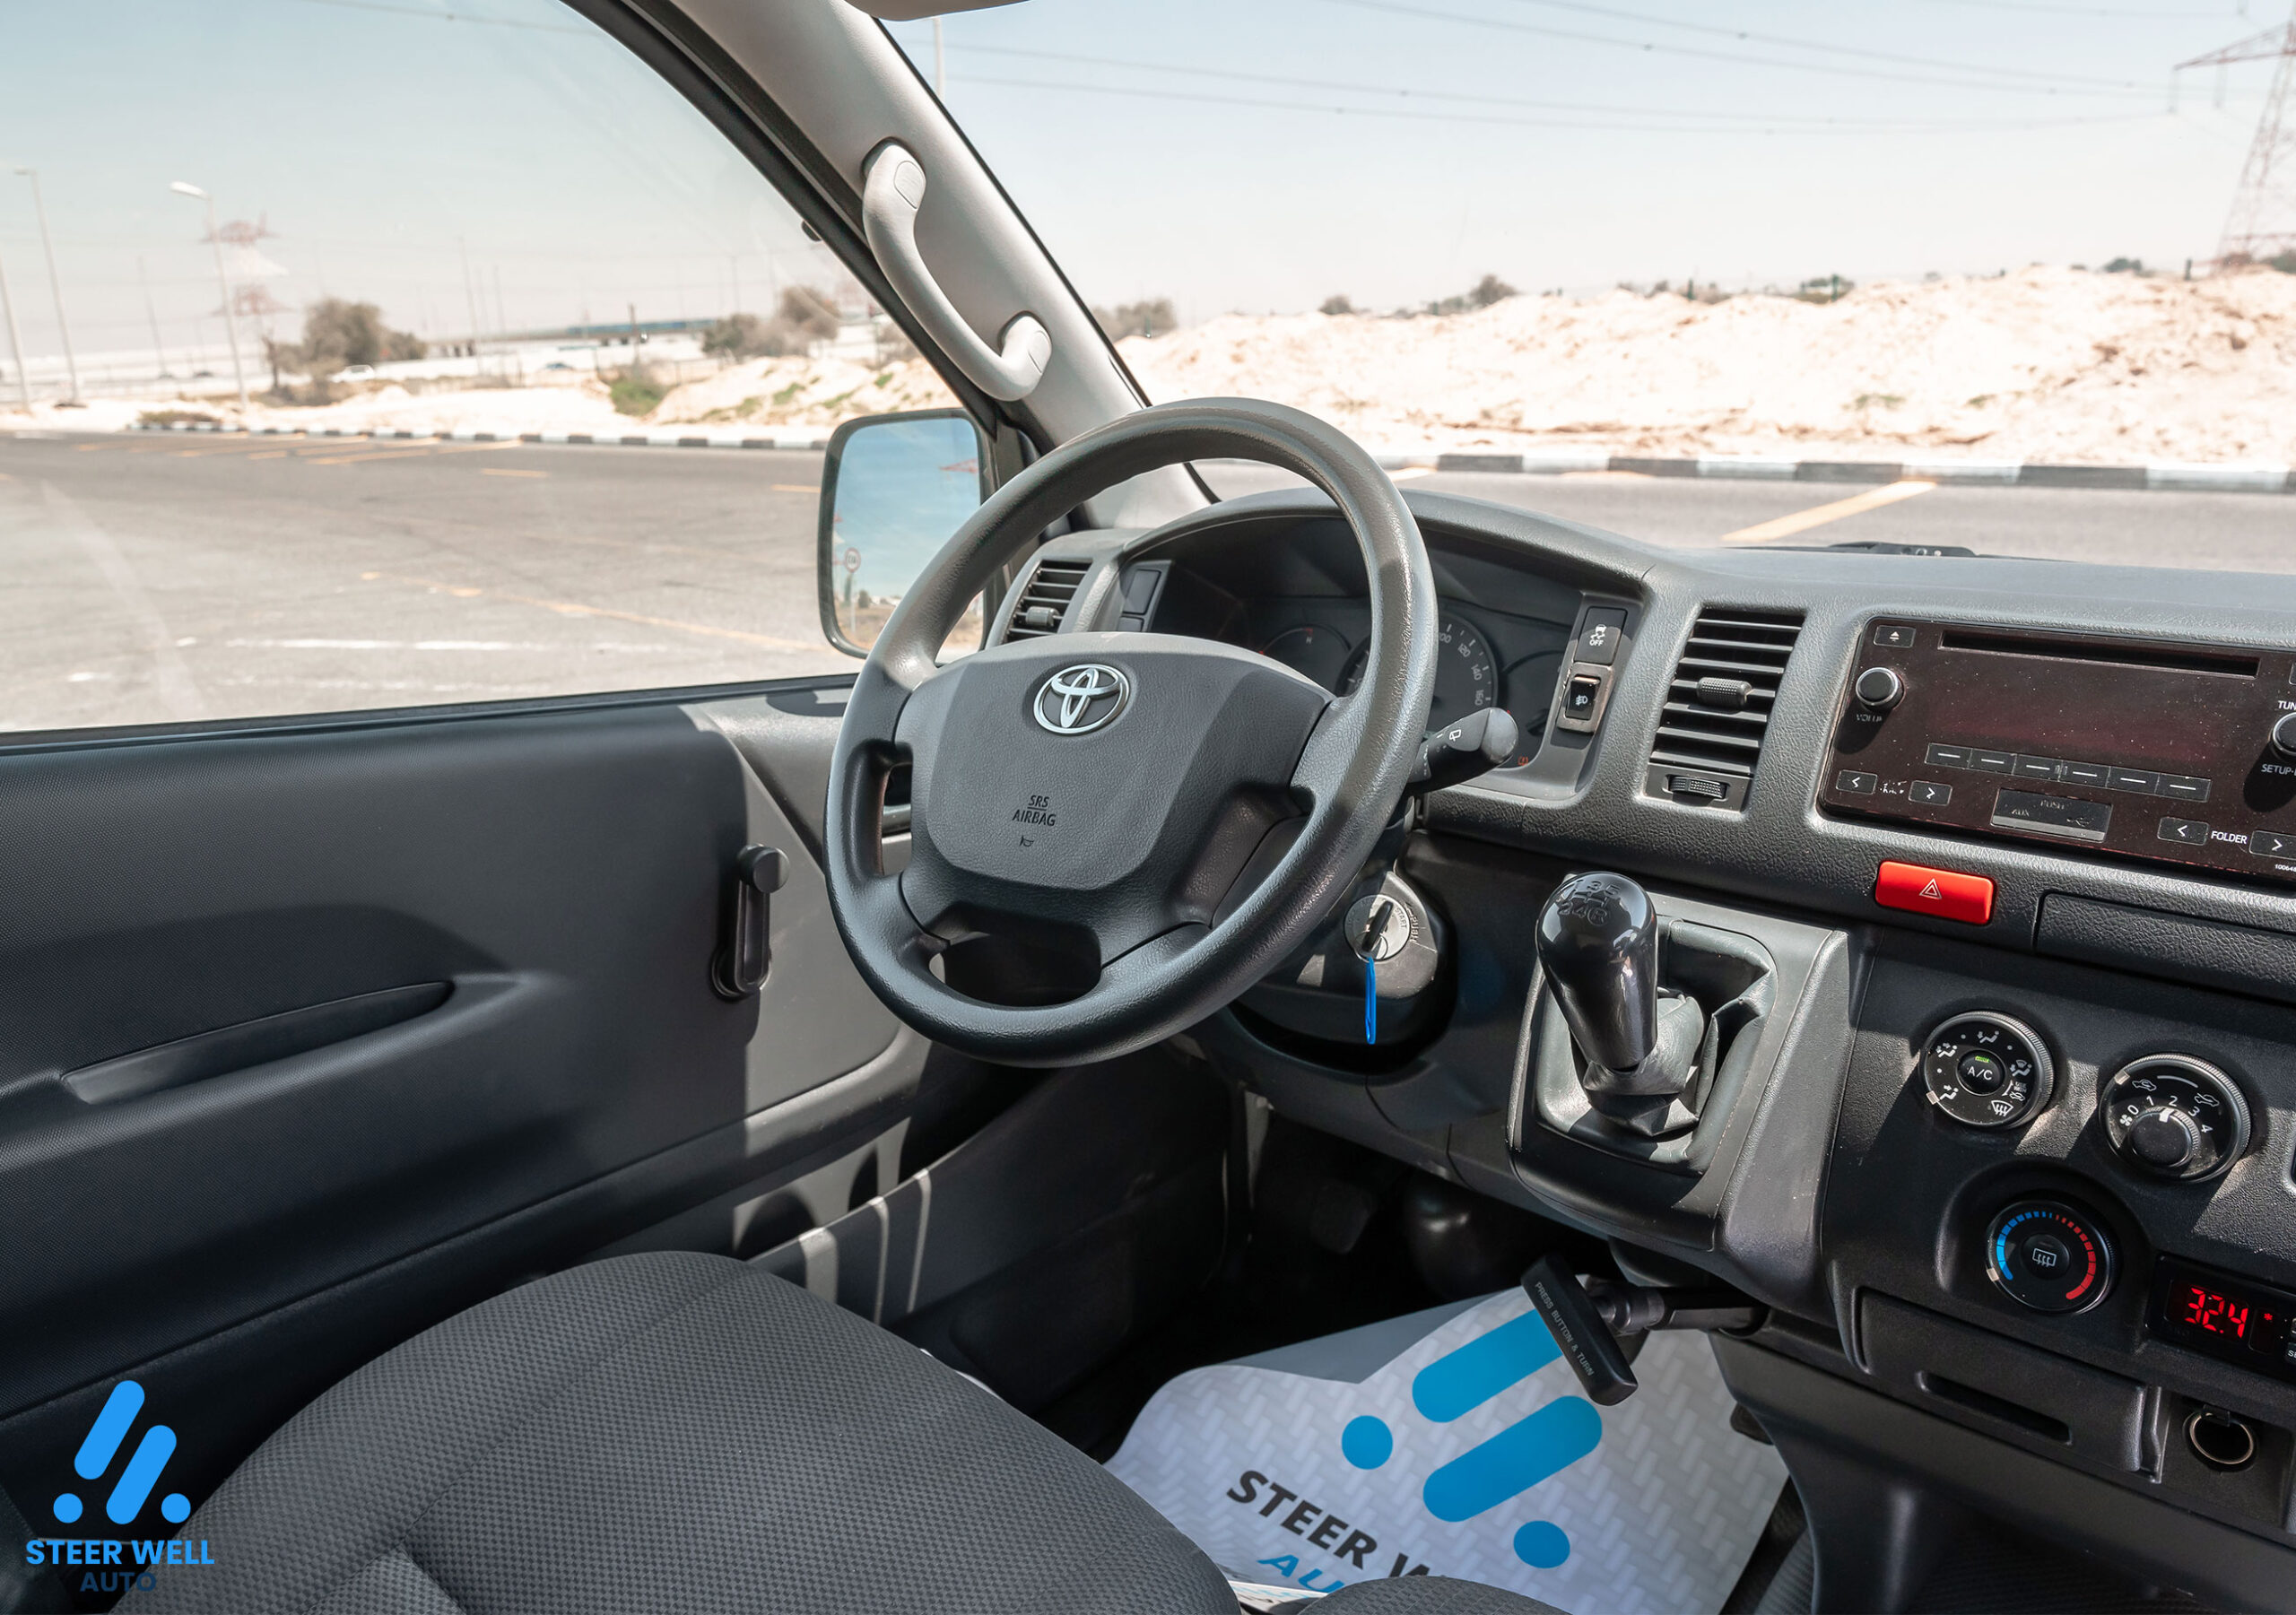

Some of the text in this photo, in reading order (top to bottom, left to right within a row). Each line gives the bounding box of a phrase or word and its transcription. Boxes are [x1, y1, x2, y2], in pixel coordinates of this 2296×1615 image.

[1457, 643, 1471, 657] 120
[1471, 664, 1483, 681] 140
[1028, 794, 1049, 808] SRS
[1012, 809, 1057, 827] AIRBAG
[2211, 830, 2248, 845] FOLDER
[1967, 1065, 1993, 1081] A/C
[2127, 1095, 2213, 1133] 0 1 2 3 4
[2185, 1287, 2248, 1338] 32.4
[1535, 1281, 1595, 1376] PRESS BUTTON & TURN
[1226, 1470, 1378, 1570] STEER
